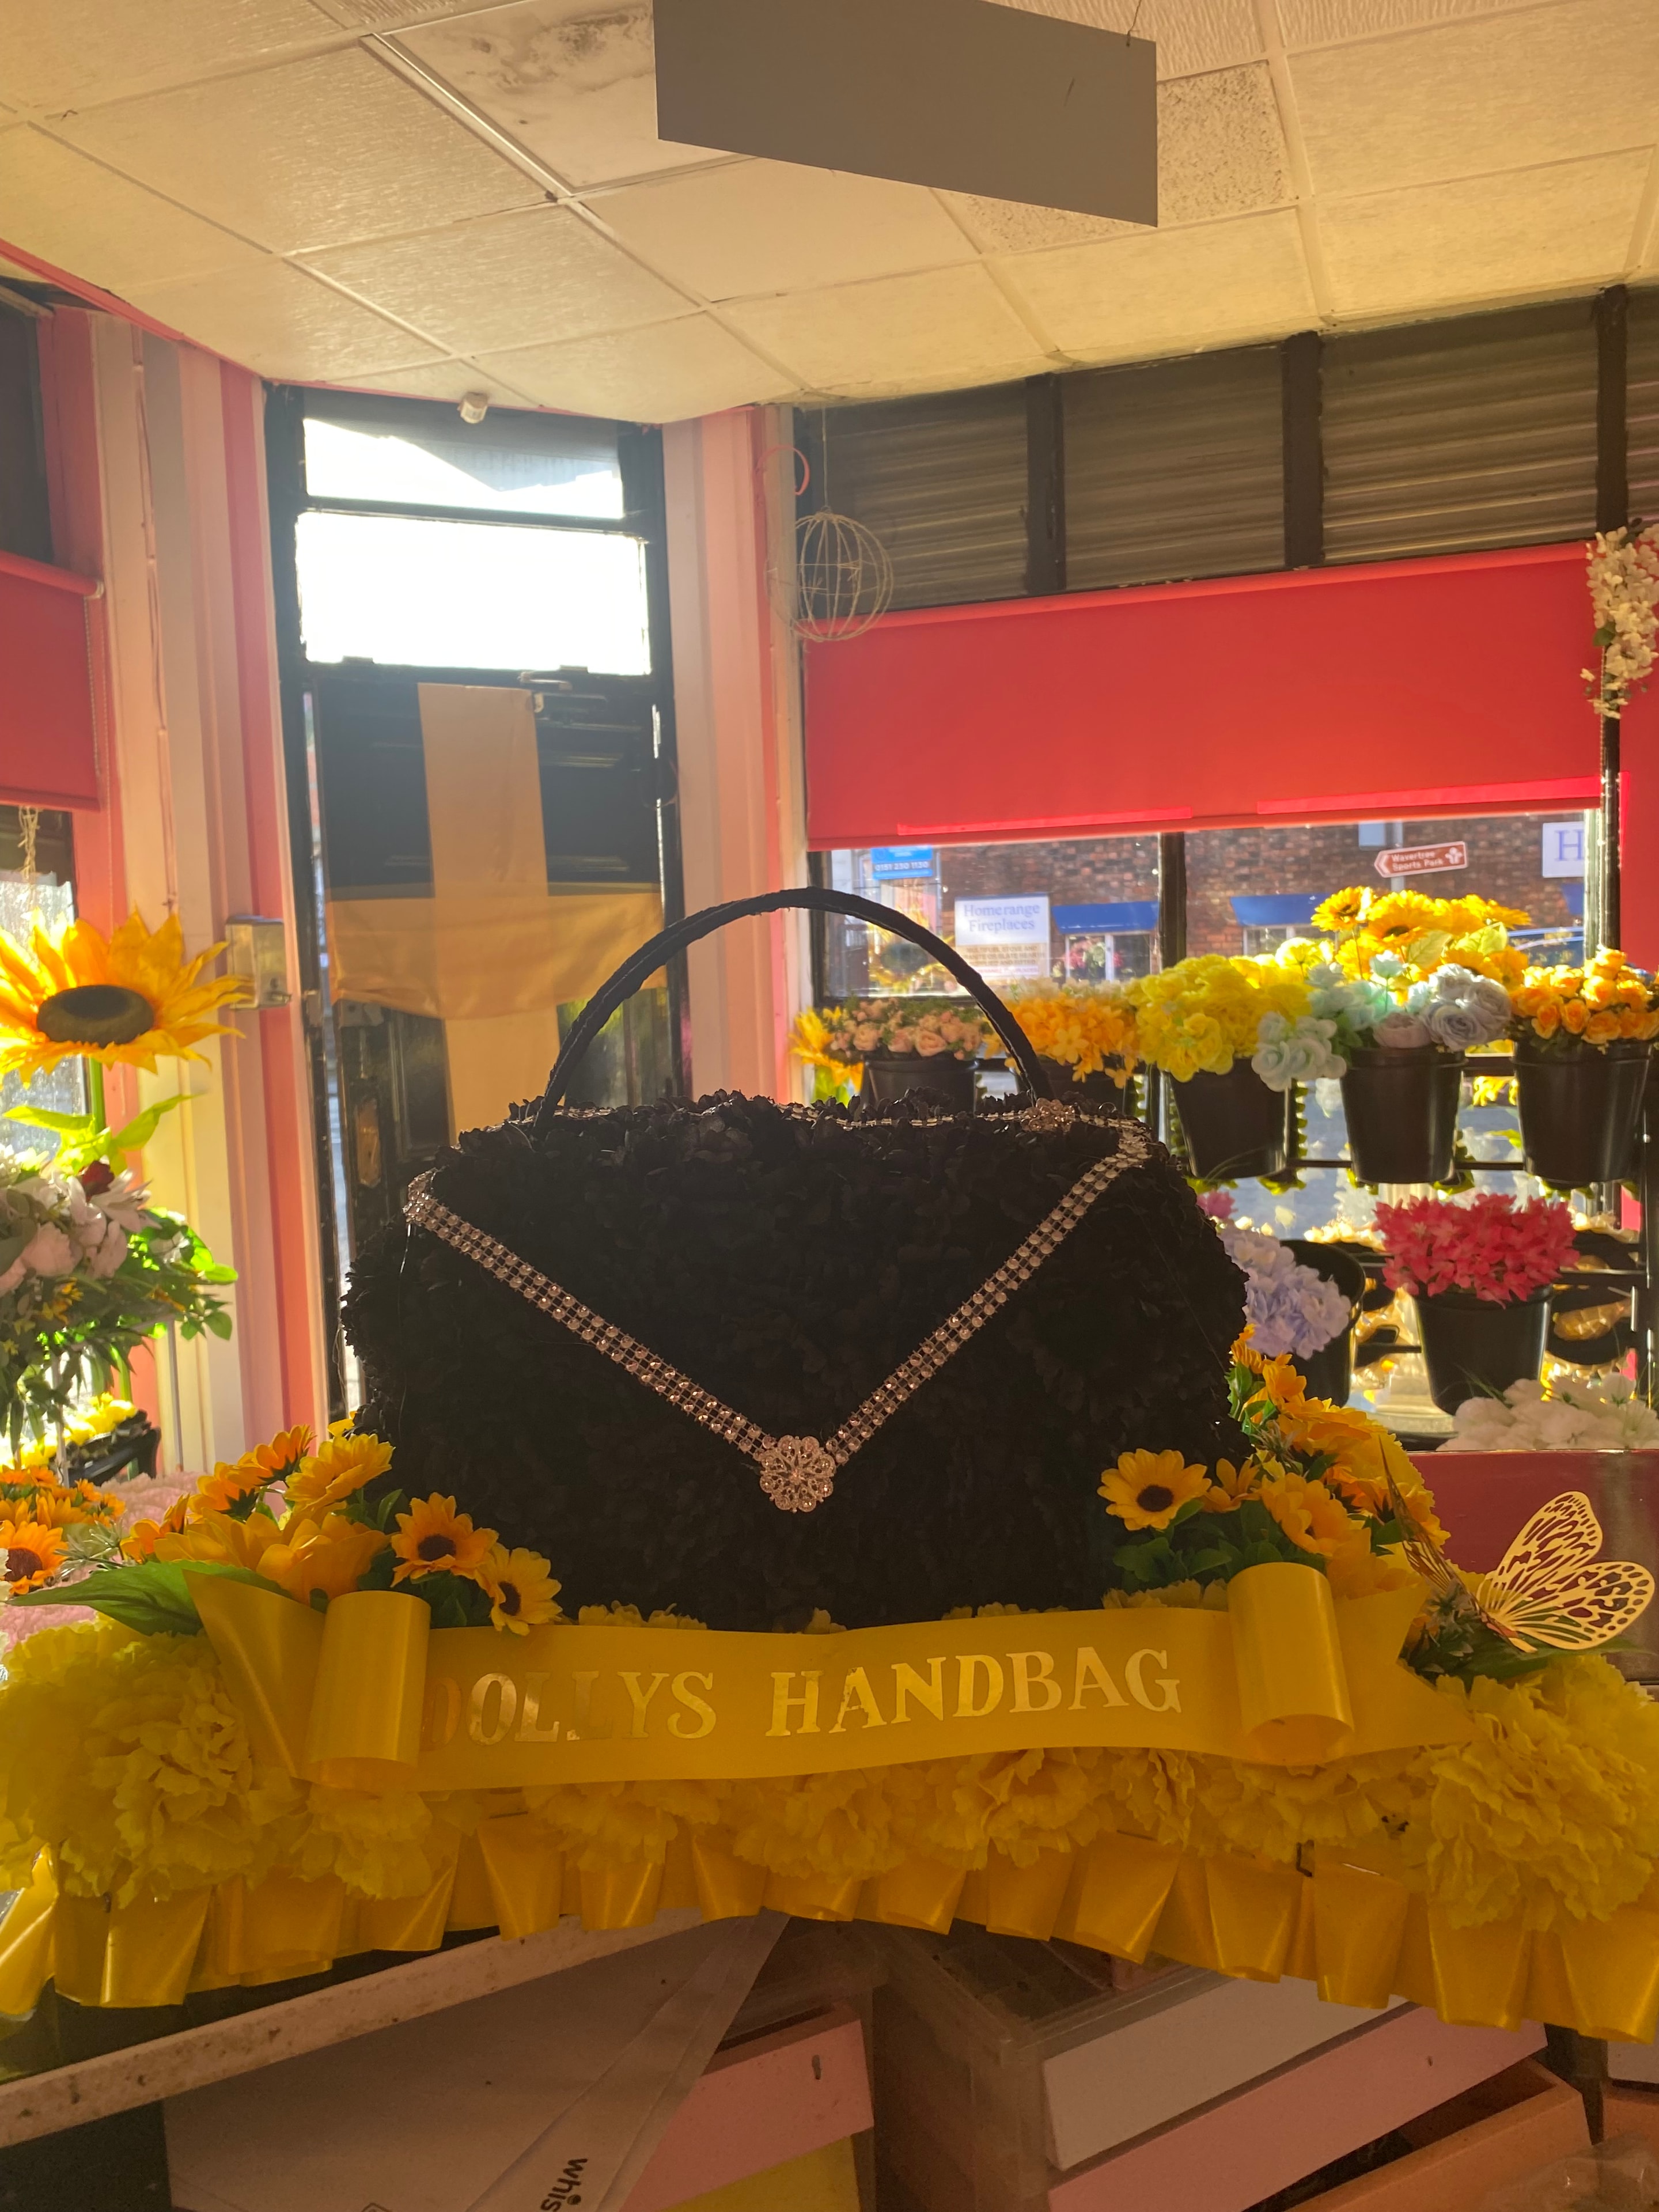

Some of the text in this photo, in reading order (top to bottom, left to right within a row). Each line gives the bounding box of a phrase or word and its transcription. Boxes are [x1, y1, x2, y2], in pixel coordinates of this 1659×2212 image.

[1391, 851, 1435, 862] Wavertree
[874, 861, 929, 871] 0151 230 1130
[1392, 859, 1444, 872] Sports Park
[969, 919, 1035, 934] Fireplaces
[419, 1646, 1181, 1752] DOLLYS HANDBAG
